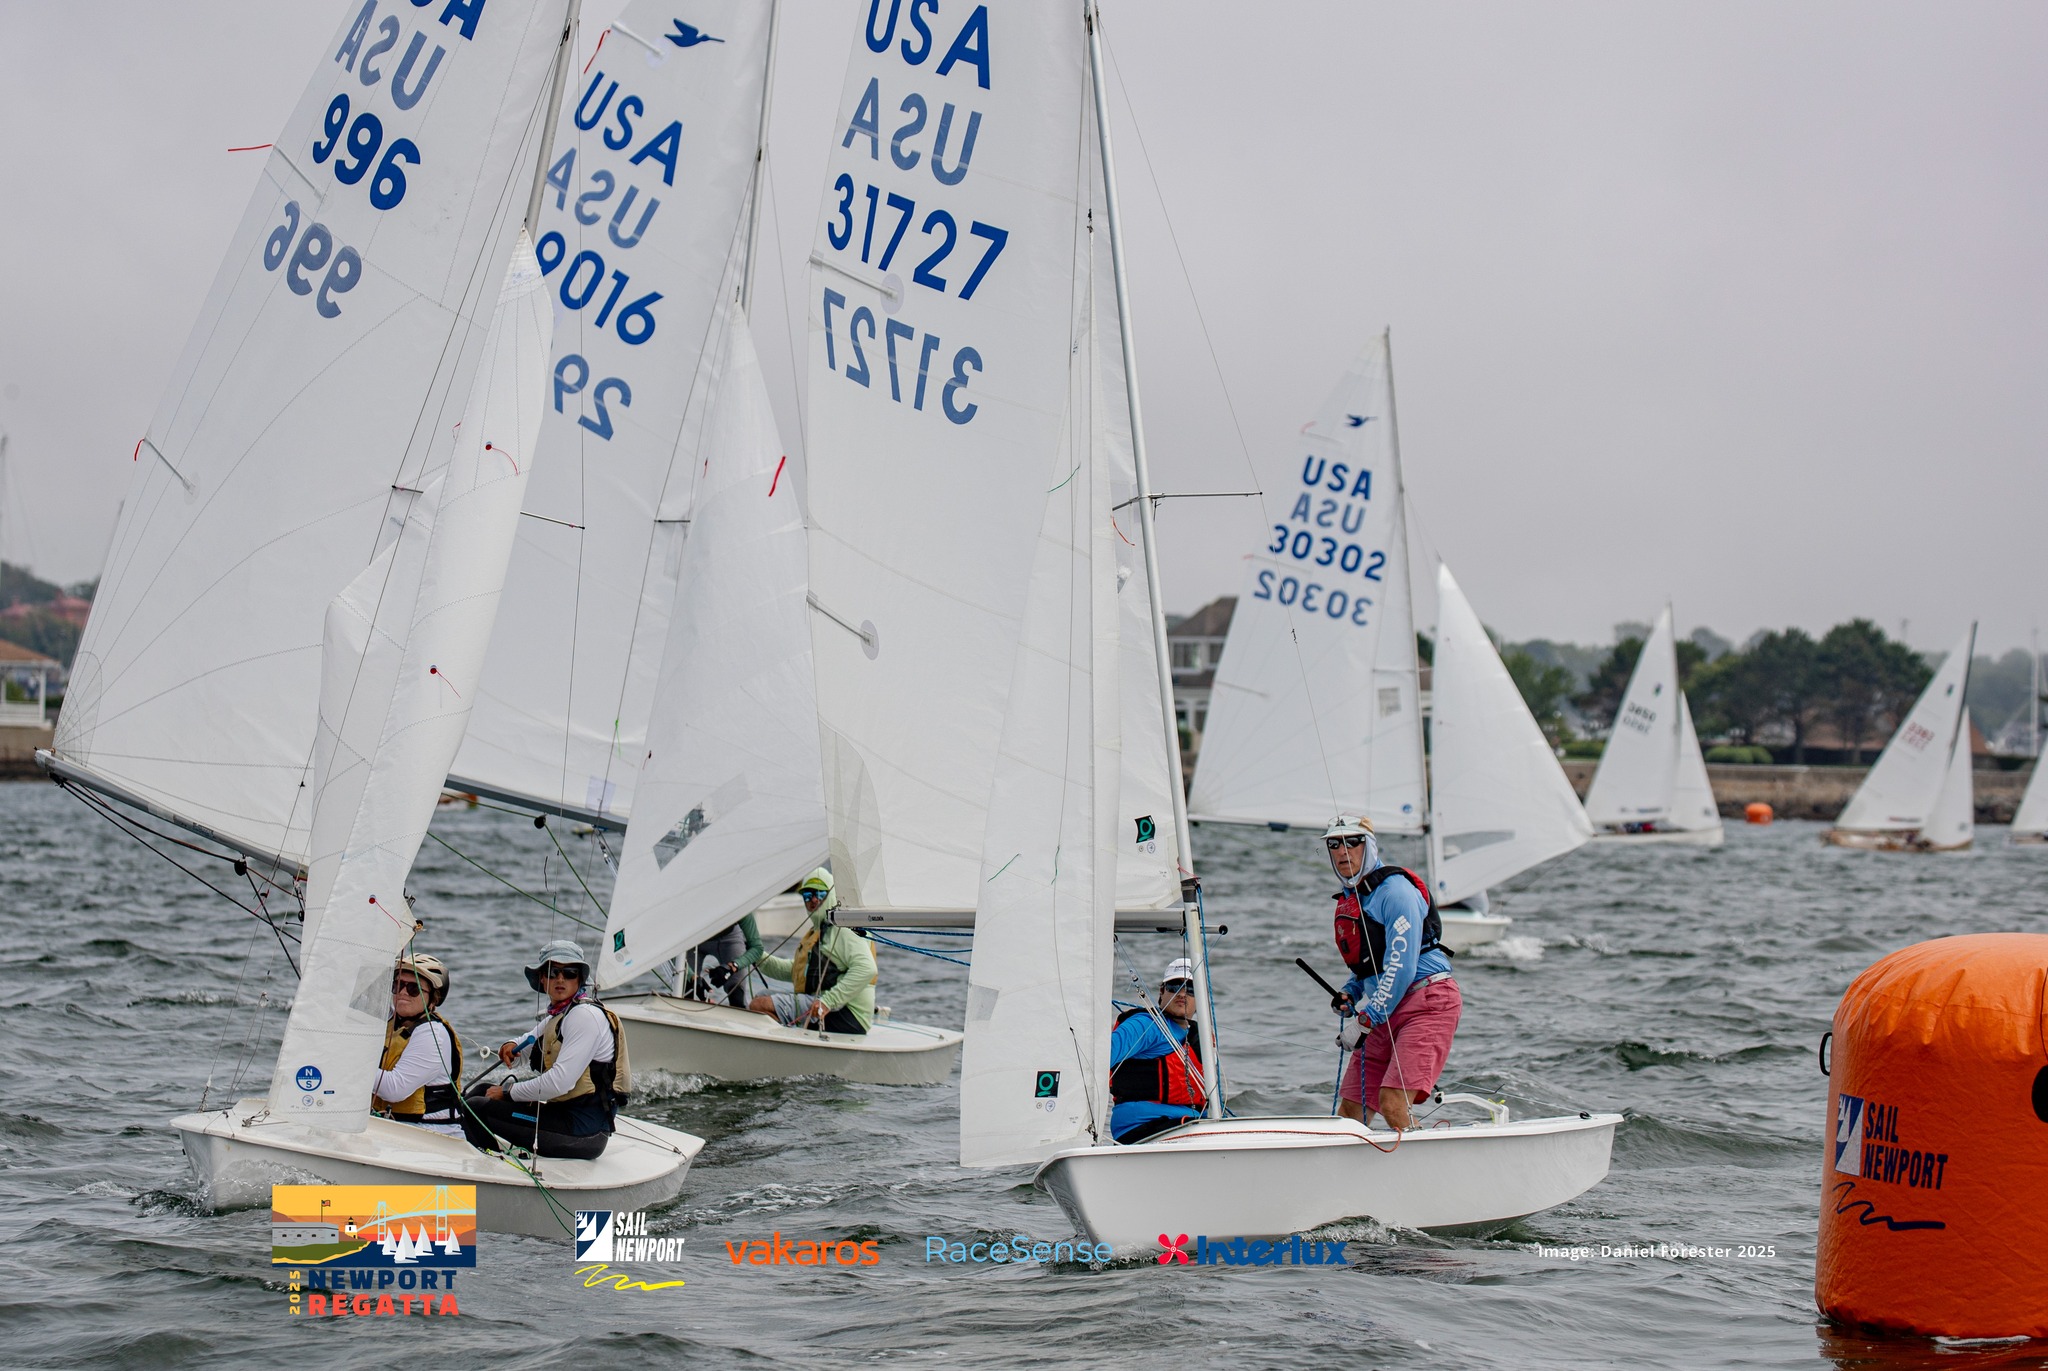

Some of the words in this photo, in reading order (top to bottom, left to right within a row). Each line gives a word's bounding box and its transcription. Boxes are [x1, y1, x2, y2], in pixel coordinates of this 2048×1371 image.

[865, 0, 991, 90] USA
[312, 93, 421, 210] 996
[574, 71, 683, 187] USA
[827, 172, 1010, 301] 31727
[1302, 455, 1373, 501] USA
[1267, 523, 1388, 582] 30302
[305, 1068, 313, 1077] N
[305, 1080, 313, 1089] S
[1865, 1101, 1899, 1143] SAIL
[1863, 1143, 1949, 1190] NEWPORT
